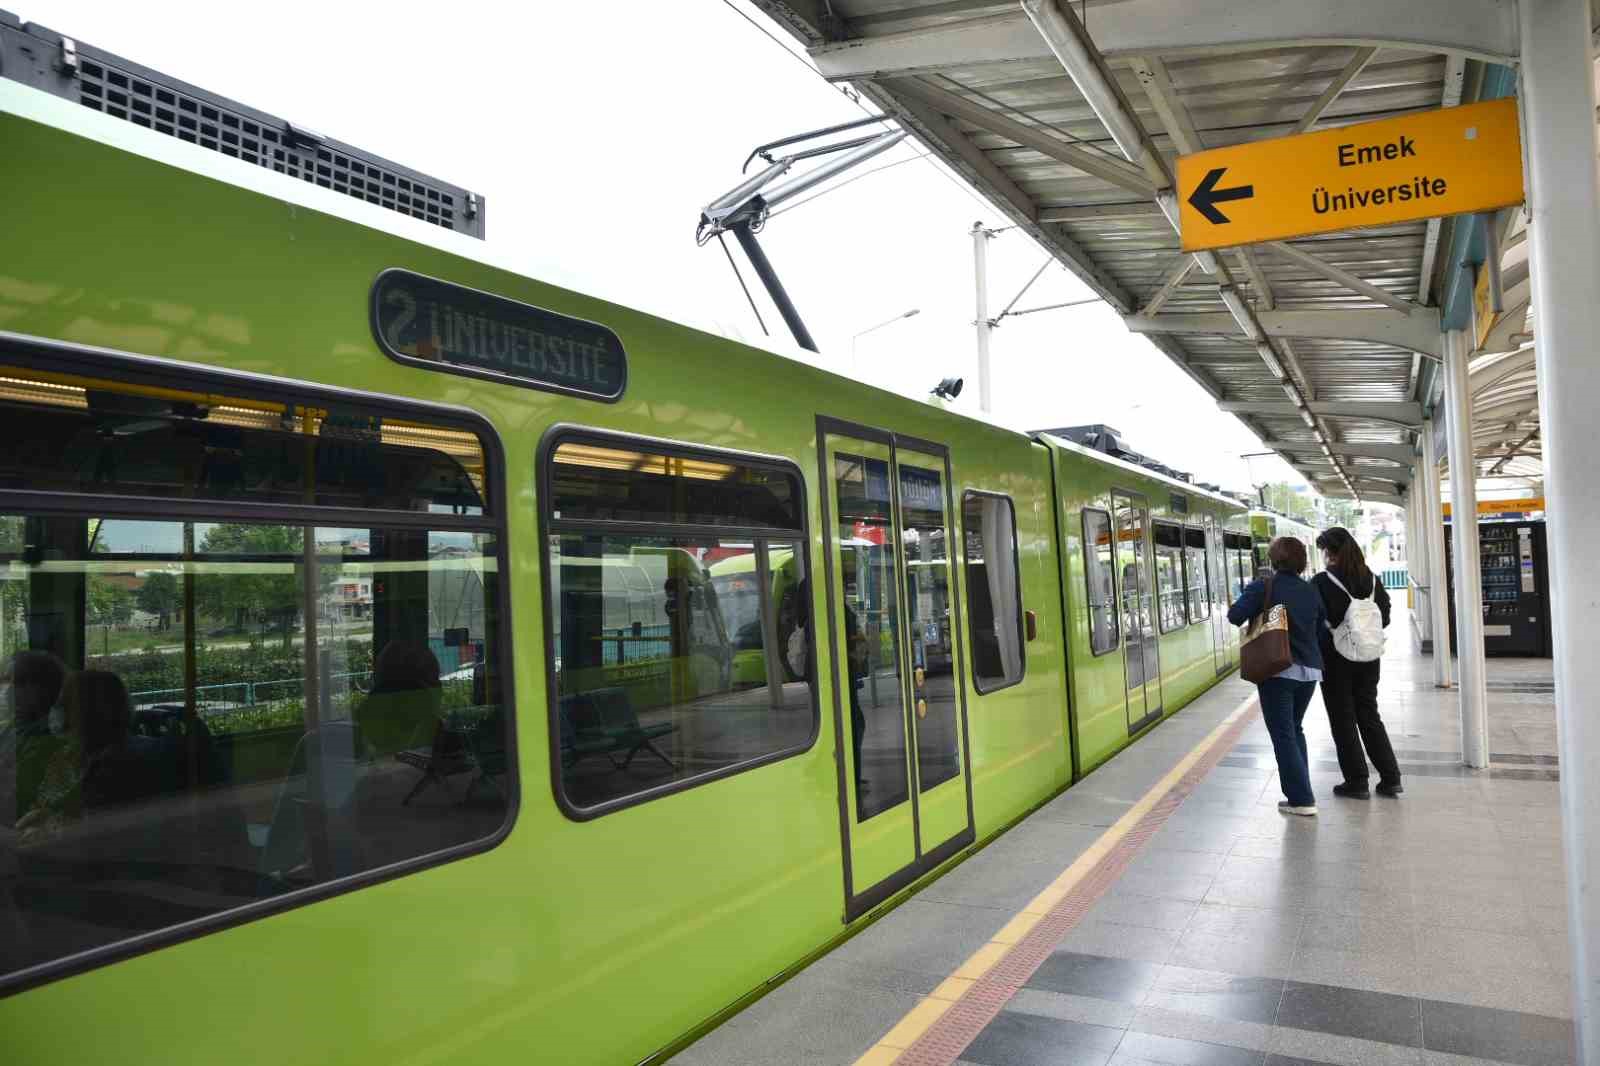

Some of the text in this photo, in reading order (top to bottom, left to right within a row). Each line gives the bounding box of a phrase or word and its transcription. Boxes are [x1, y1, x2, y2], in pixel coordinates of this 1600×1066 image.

[1338, 136, 1416, 167] Emek
[1312, 176, 1447, 214] Üniversite
[385, 288, 416, 355] 2
